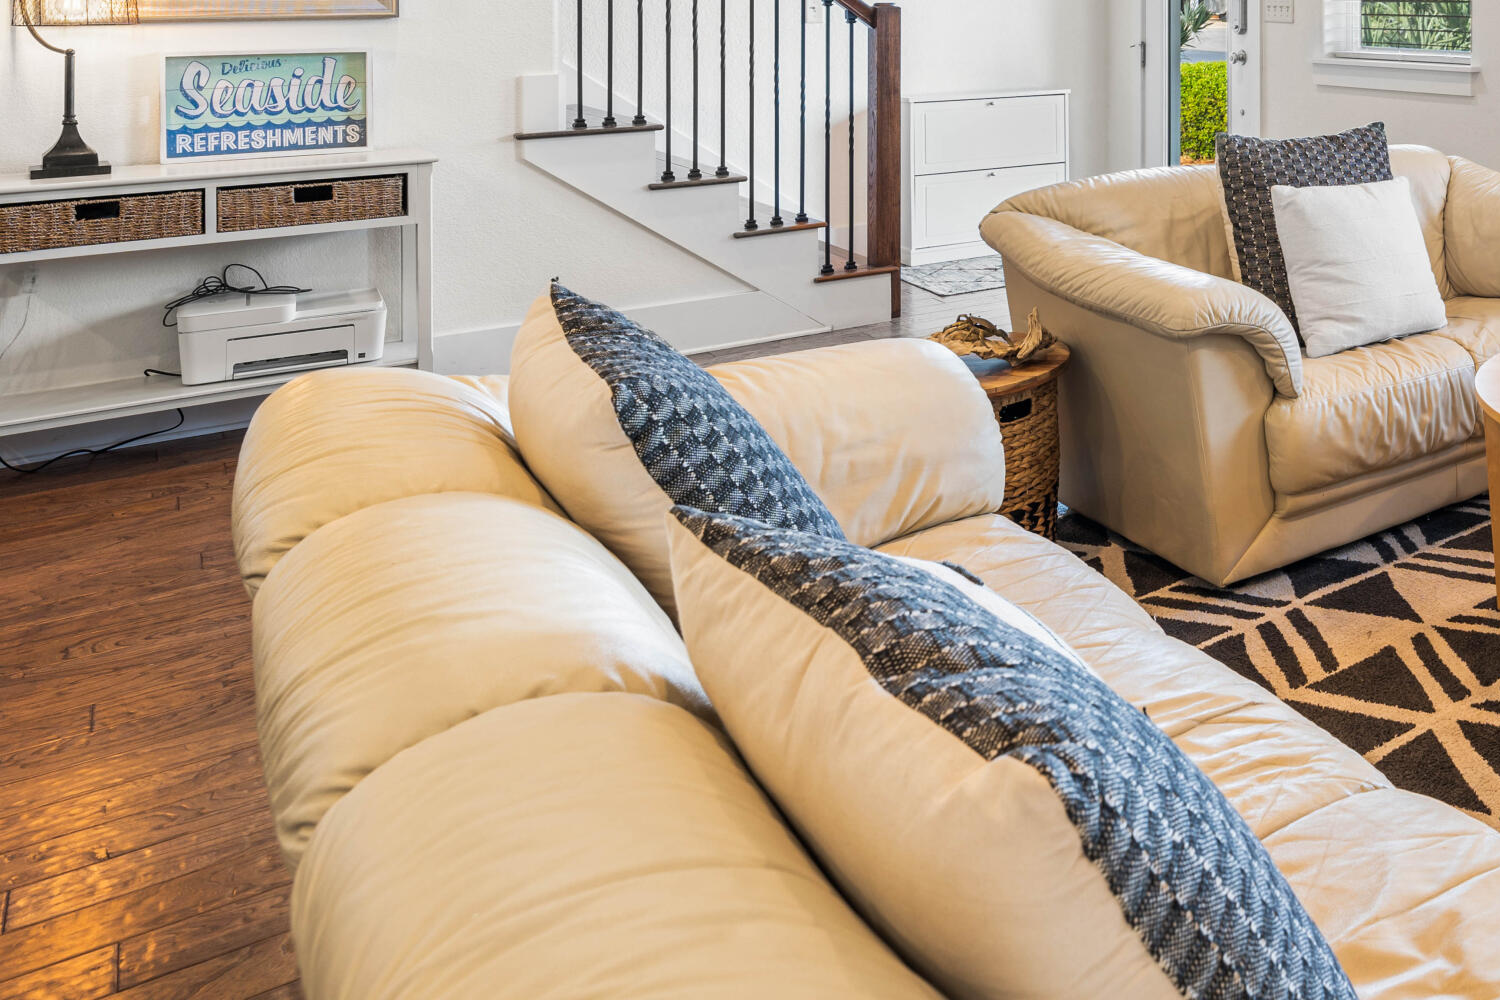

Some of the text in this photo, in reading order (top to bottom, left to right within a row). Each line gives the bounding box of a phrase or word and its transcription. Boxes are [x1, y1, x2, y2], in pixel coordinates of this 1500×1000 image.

[221, 57, 282, 76] Delicious
[174, 56, 361, 120] Seaside
[175, 124, 361, 154] REFRESHMENTS
